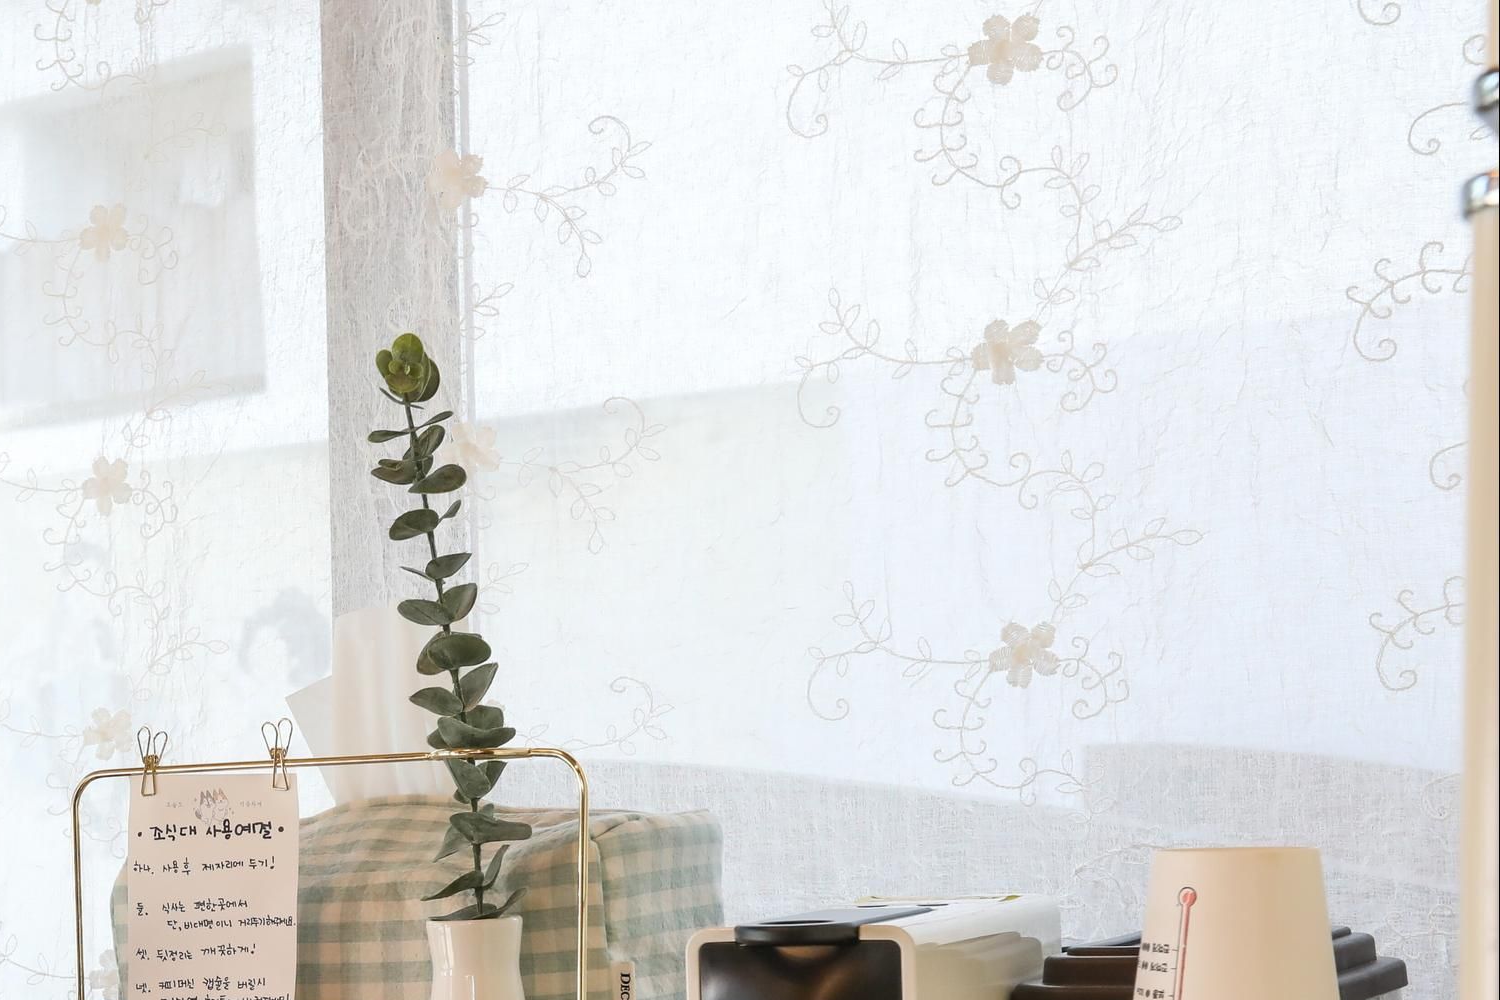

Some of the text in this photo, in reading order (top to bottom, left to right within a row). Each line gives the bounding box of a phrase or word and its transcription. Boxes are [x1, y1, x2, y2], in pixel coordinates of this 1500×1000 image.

[150, 818, 272, 841] 조식대 사용예절
[133, 860, 154, 875] 하나.
[202, 861, 244, 871] 제자리에
[248, 855, 275, 870] 두기!
[136, 902, 149, 916] 둘.
[162, 900, 186, 914] 식사는
[156, 950, 193, 962] 뒷정리는
[158, 978, 195, 990] 커피머신
[202, 975, 231, 991] 캡슐을
